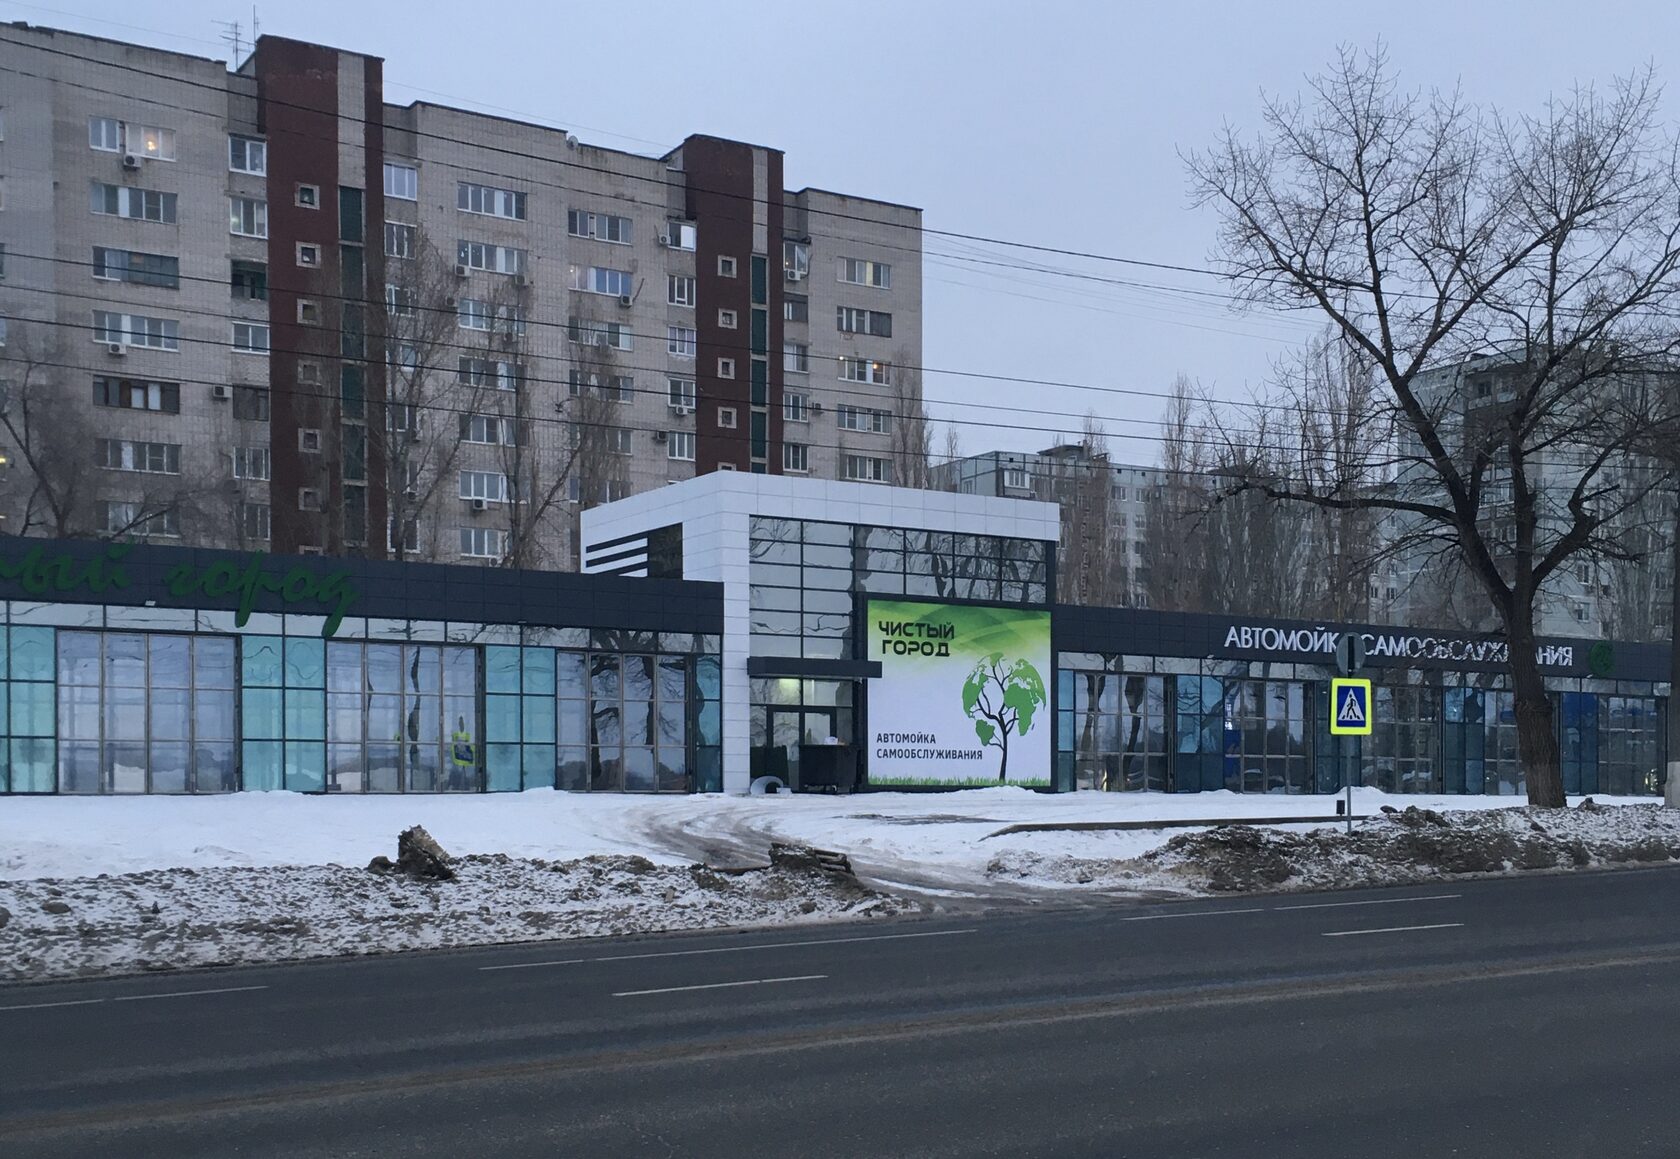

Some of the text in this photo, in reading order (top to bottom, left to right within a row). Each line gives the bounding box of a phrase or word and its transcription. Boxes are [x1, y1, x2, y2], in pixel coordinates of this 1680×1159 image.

[0, 535, 361, 638] ый город
[878, 621, 955, 640] ЧИСТЫЙ
[882, 639, 951, 657] ГОРОД
[1224, 625, 1573, 667] АВТОМОЙК САМООБСЛУЖНИЯ
[876, 731, 937, 744] АВТОМОЙКА
[876, 748, 983, 760] САМООБСЛУЖИВАНИЯ
